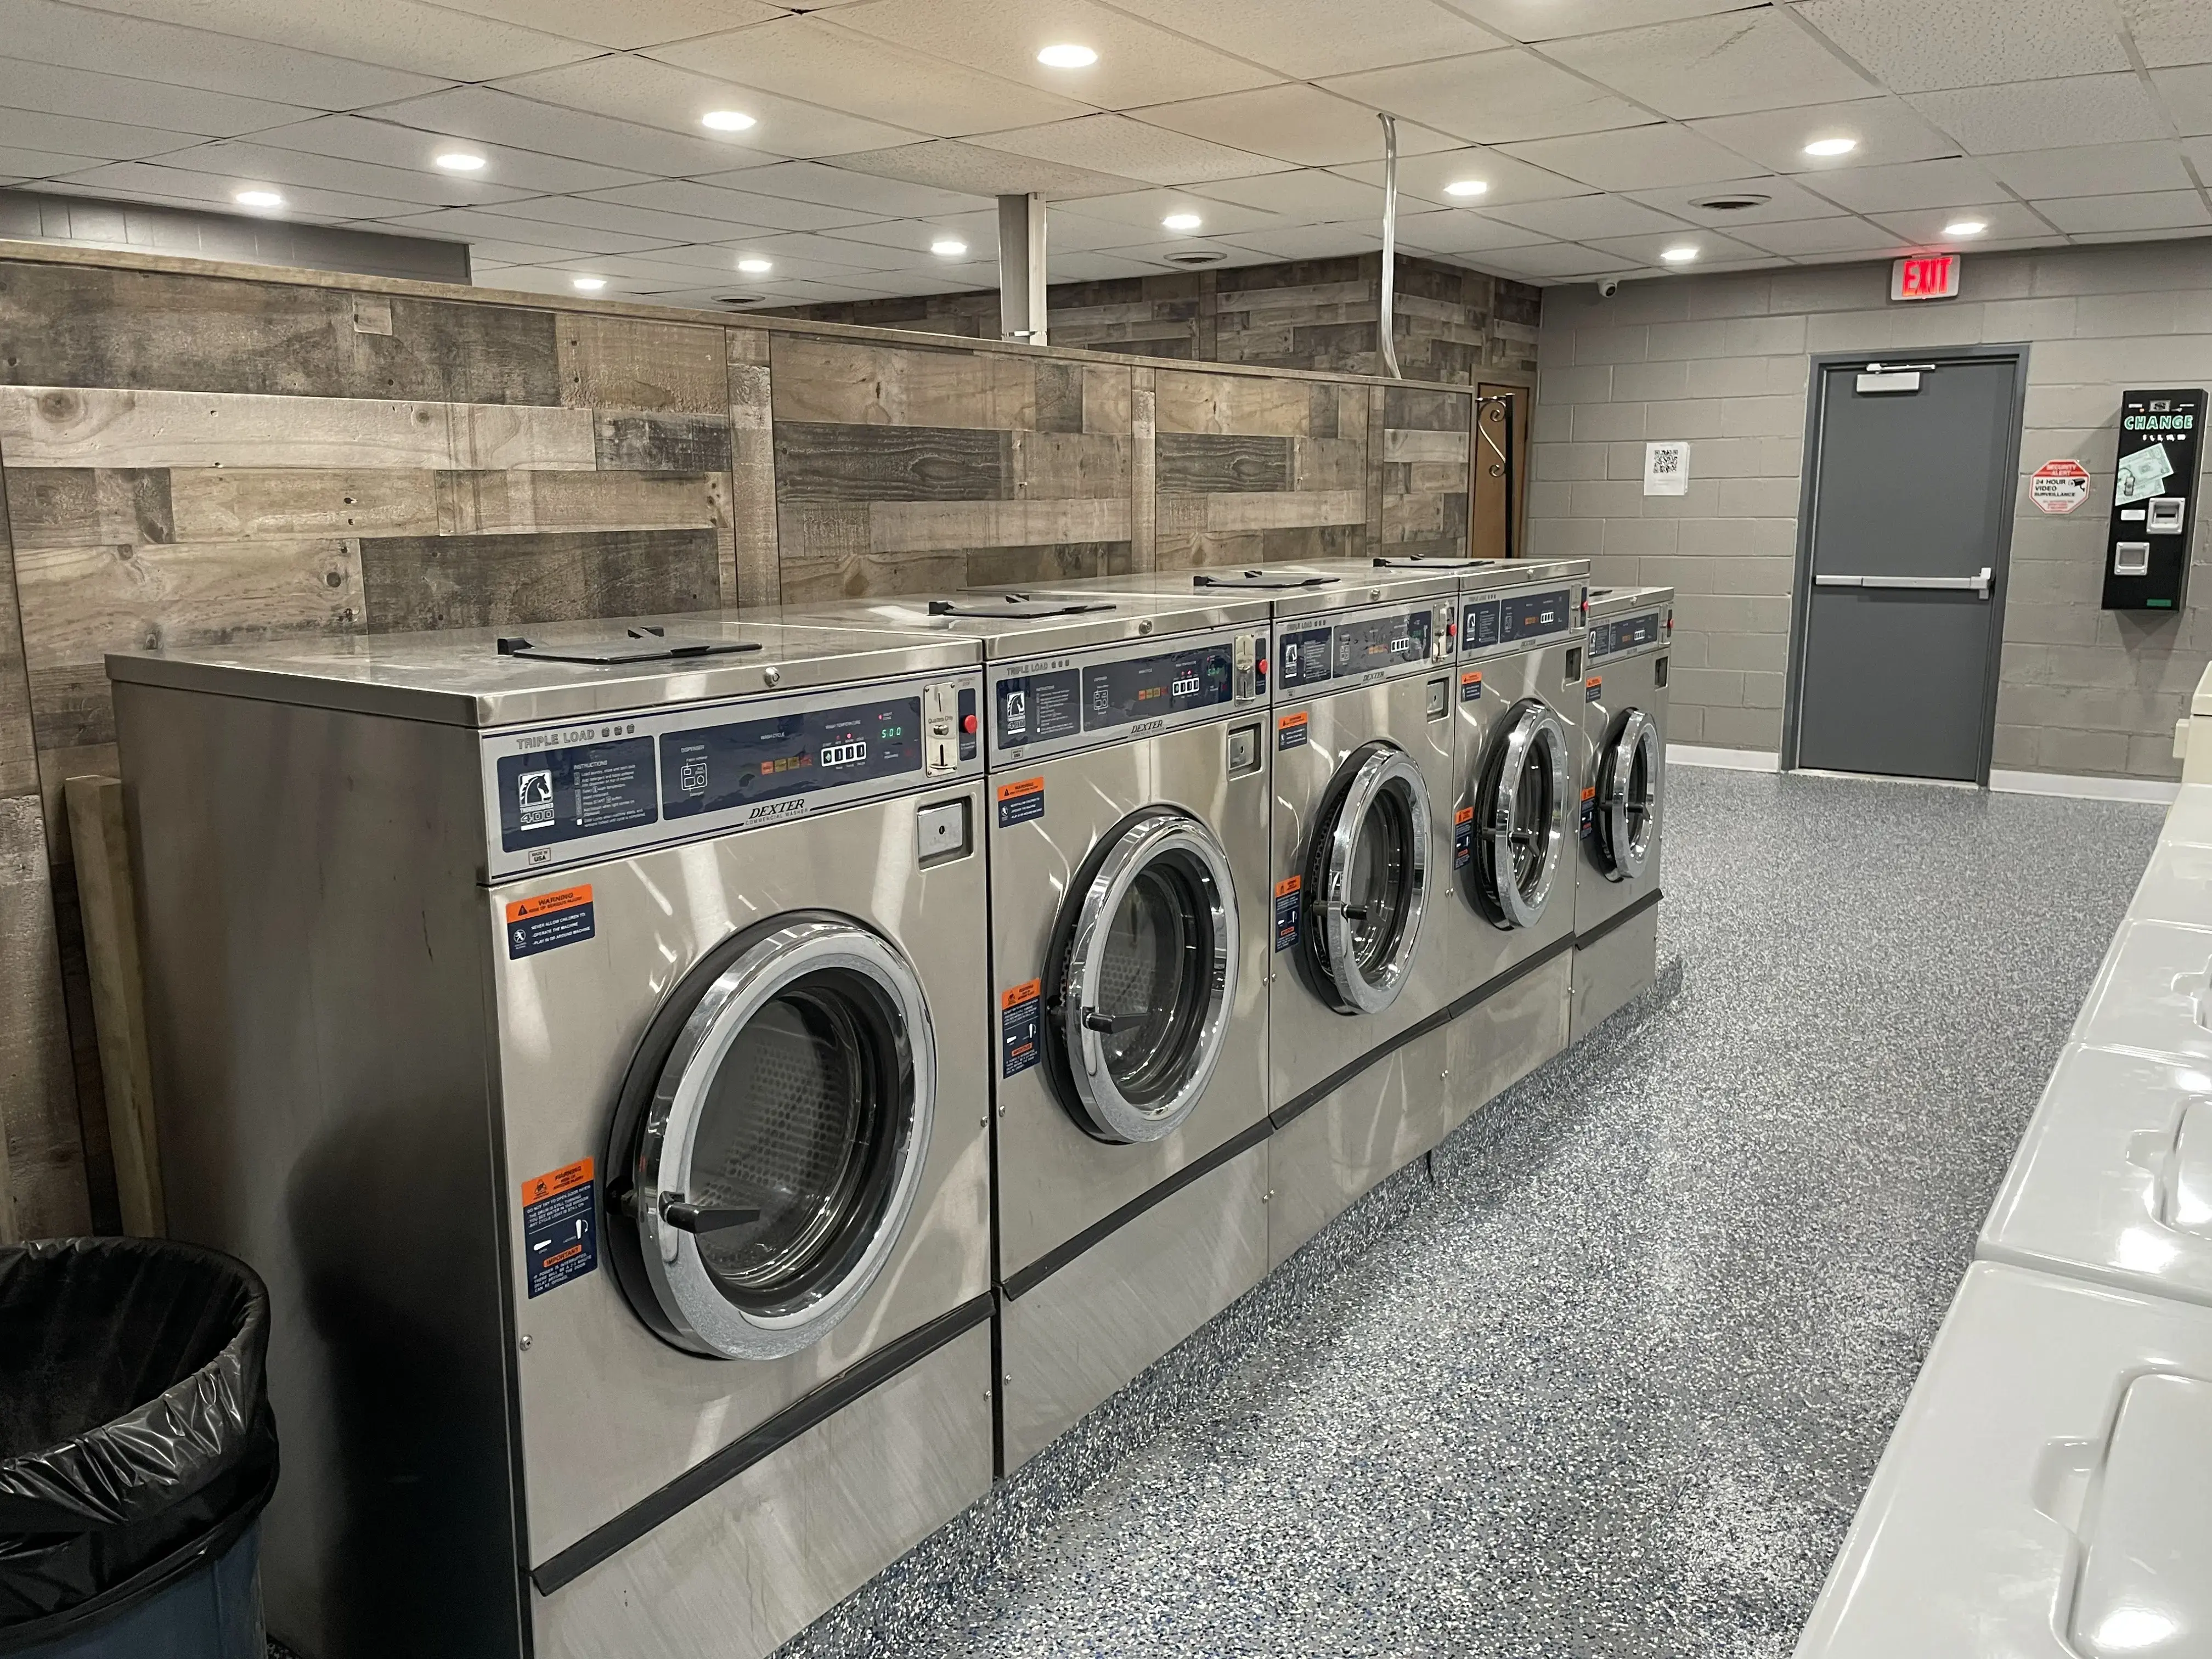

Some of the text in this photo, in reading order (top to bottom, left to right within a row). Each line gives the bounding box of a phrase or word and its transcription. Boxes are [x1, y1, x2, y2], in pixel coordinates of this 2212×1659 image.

[1902, 257, 1953, 297] EXIT
[2124, 415, 2193, 430] CHANGE
[1007, 662, 1048, 675] TRIPLE LOAD
[1131, 719, 1163, 734] DEXTER
[516, 729, 595, 750] TRIPLE LOAD
[573, 760, 608, 770] INSTRUCTIONS
[521, 809, 555, 823] 400
[746, 808, 808, 825] COMMERCIAL WASHER
[748, 799, 804, 819] DEXTER
[538, 893, 573, 905] WARNING
[547, 1248, 579, 1265] IMPORTANT
